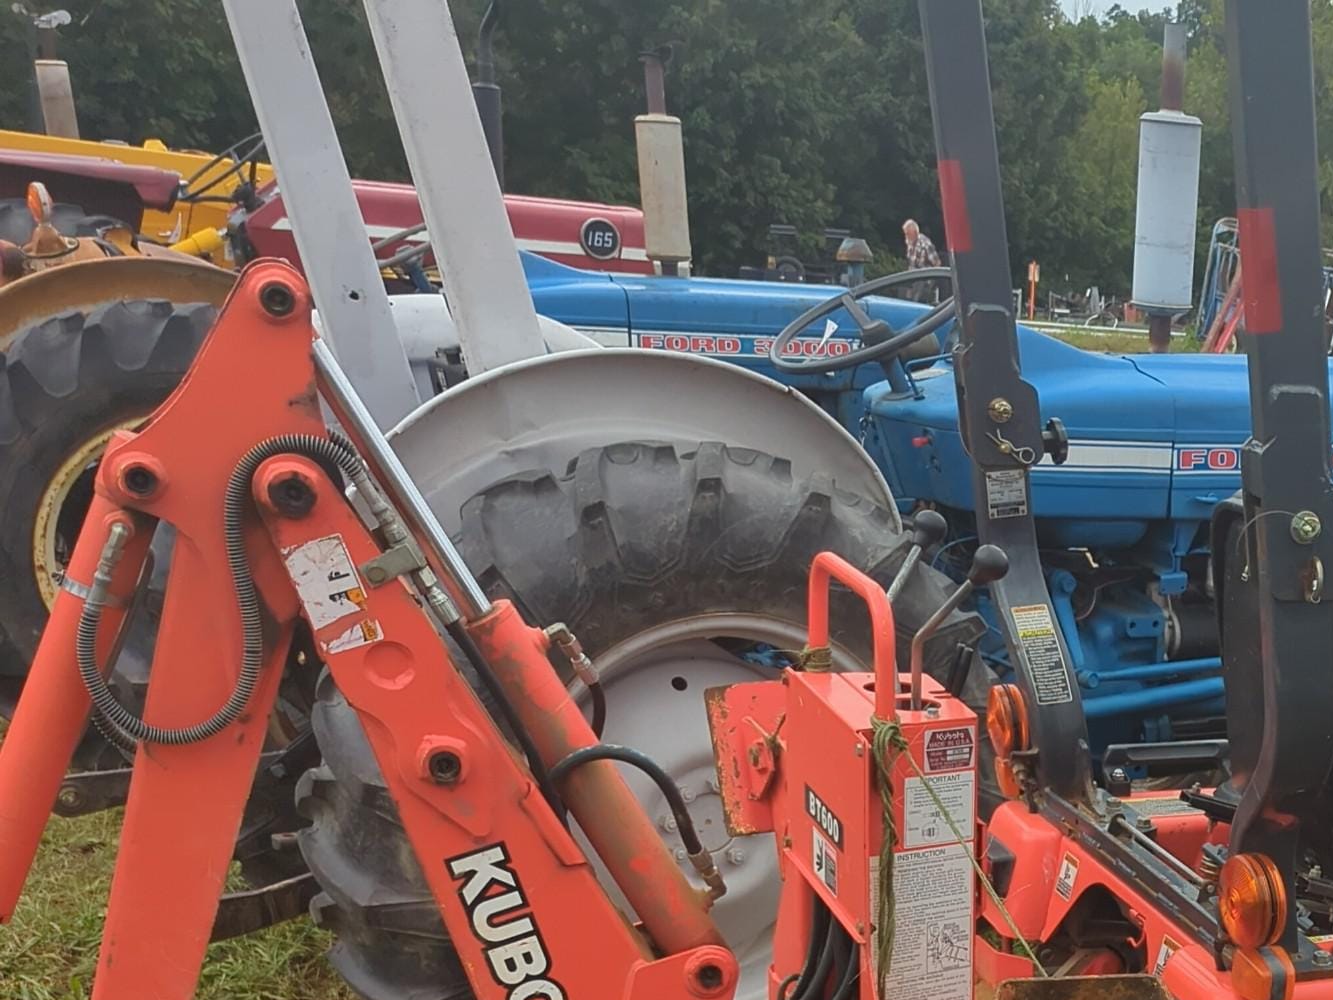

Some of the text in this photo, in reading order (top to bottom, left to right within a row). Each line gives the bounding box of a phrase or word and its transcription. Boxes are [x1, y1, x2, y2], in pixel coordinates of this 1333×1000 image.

[588, 232, 613, 248] 165
[640, 335, 851, 357] FORD 3000
[1179, 449, 1241, 470] FO
[808, 790, 840, 844] BT600
[897, 849, 946, 861] INSTRUCTION
